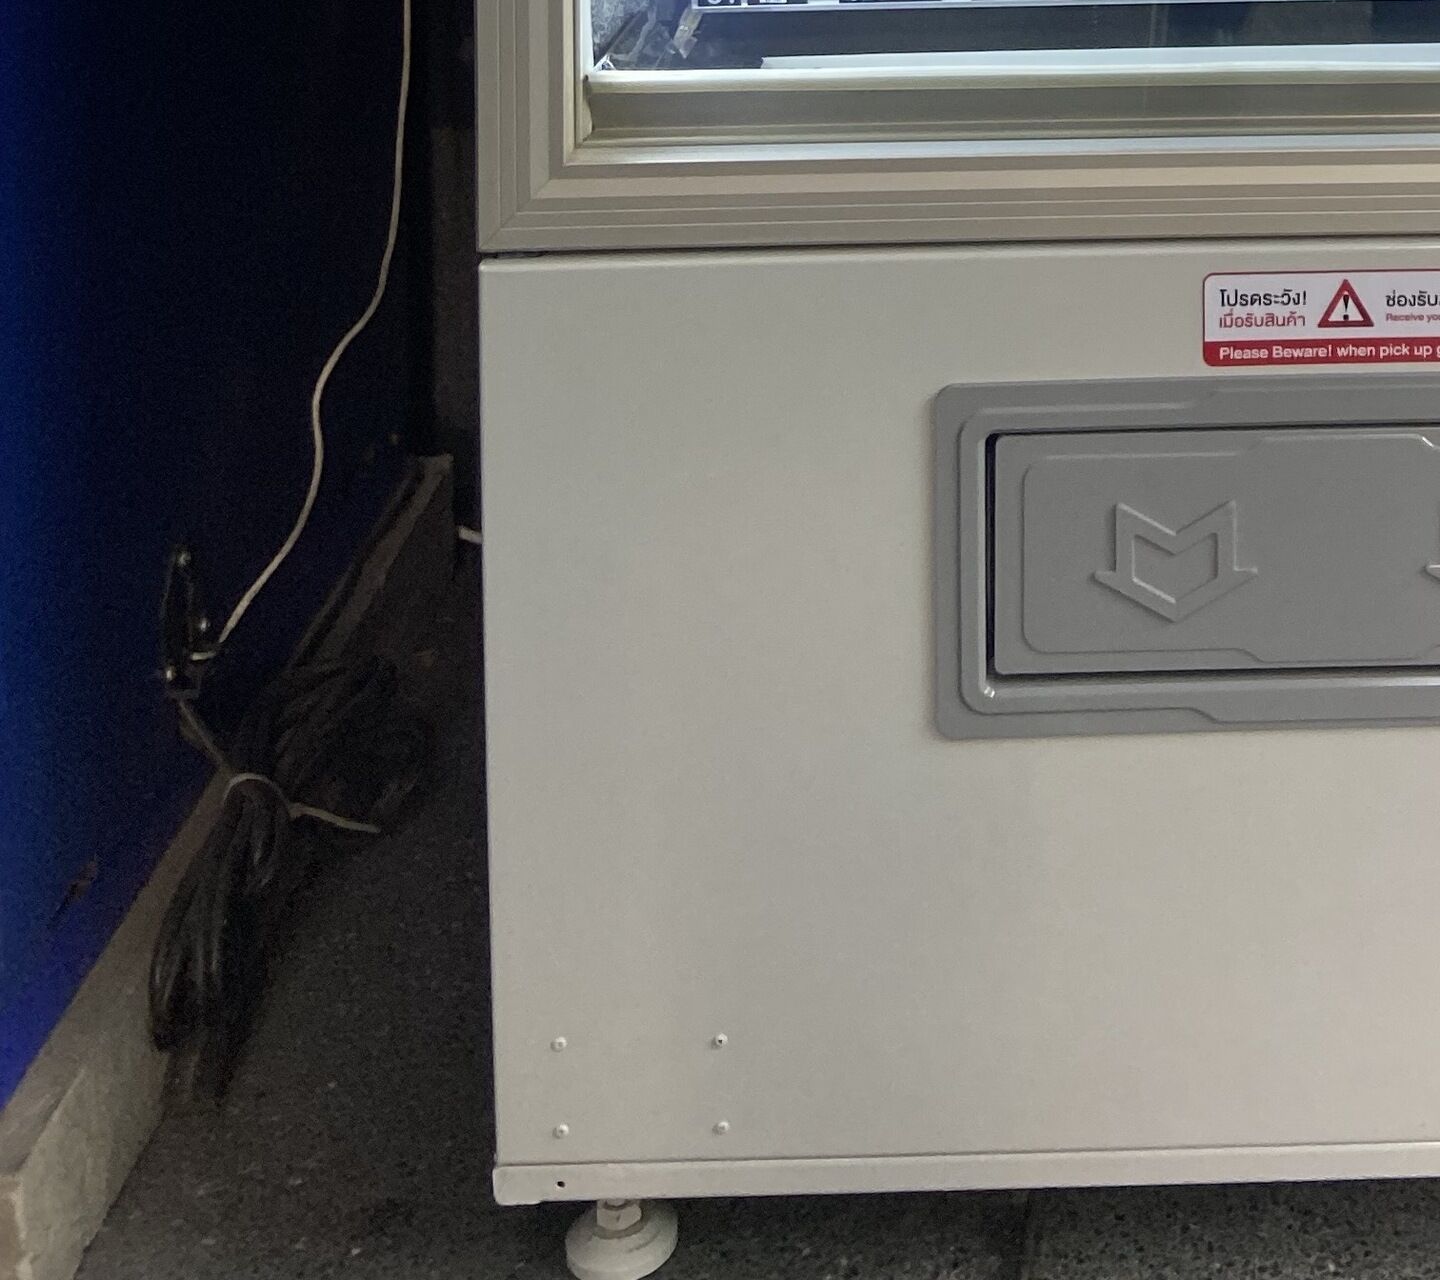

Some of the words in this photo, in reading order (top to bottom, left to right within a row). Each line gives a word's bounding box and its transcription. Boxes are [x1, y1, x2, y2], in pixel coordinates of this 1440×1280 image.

[1219, 288, 1307, 307] โปรดระวัง!
[1219, 308, 1306, 328] เมื่อรับสินค้า
[1386, 312, 1424, 322] Receive
[1219, 345, 1268, 359] Please
[1272, 344, 1332, 358] Beware!
[1336, 344, 1376, 357] when
[1380, 343, 1410, 358] pick
[1414, 345, 1433, 359] up
